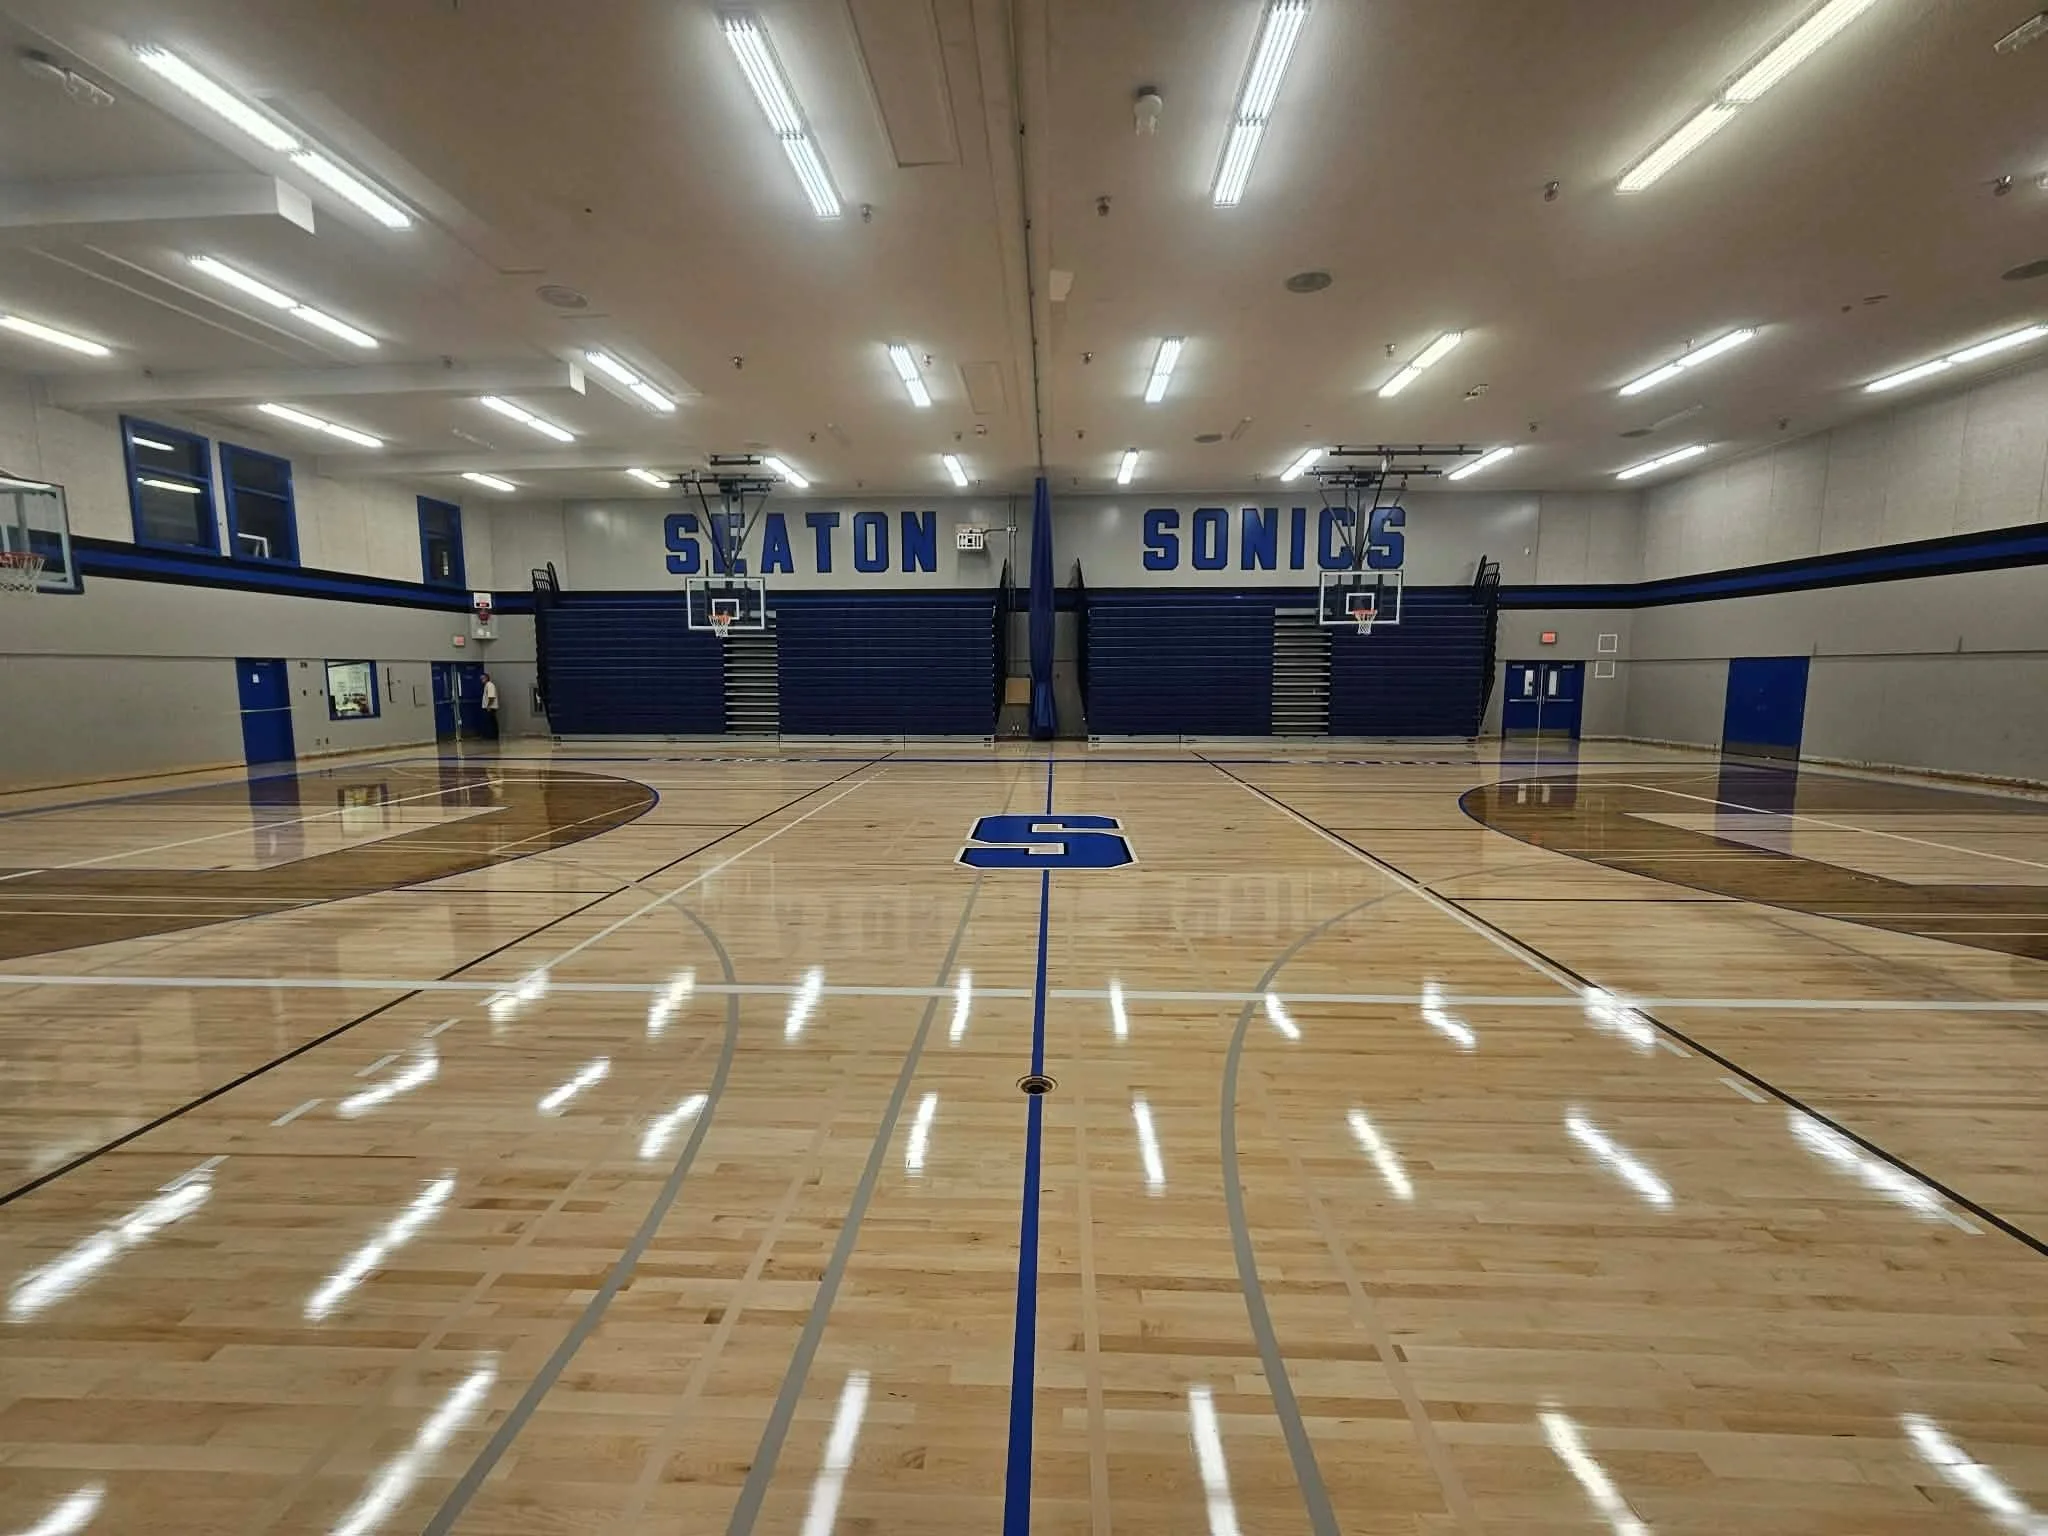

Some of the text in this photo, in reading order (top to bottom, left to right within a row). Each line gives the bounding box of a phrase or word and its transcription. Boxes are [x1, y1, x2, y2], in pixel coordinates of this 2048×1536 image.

[664, 507, 1406, 575] SEATON SONICS
[954, 815, 1140, 870] S
